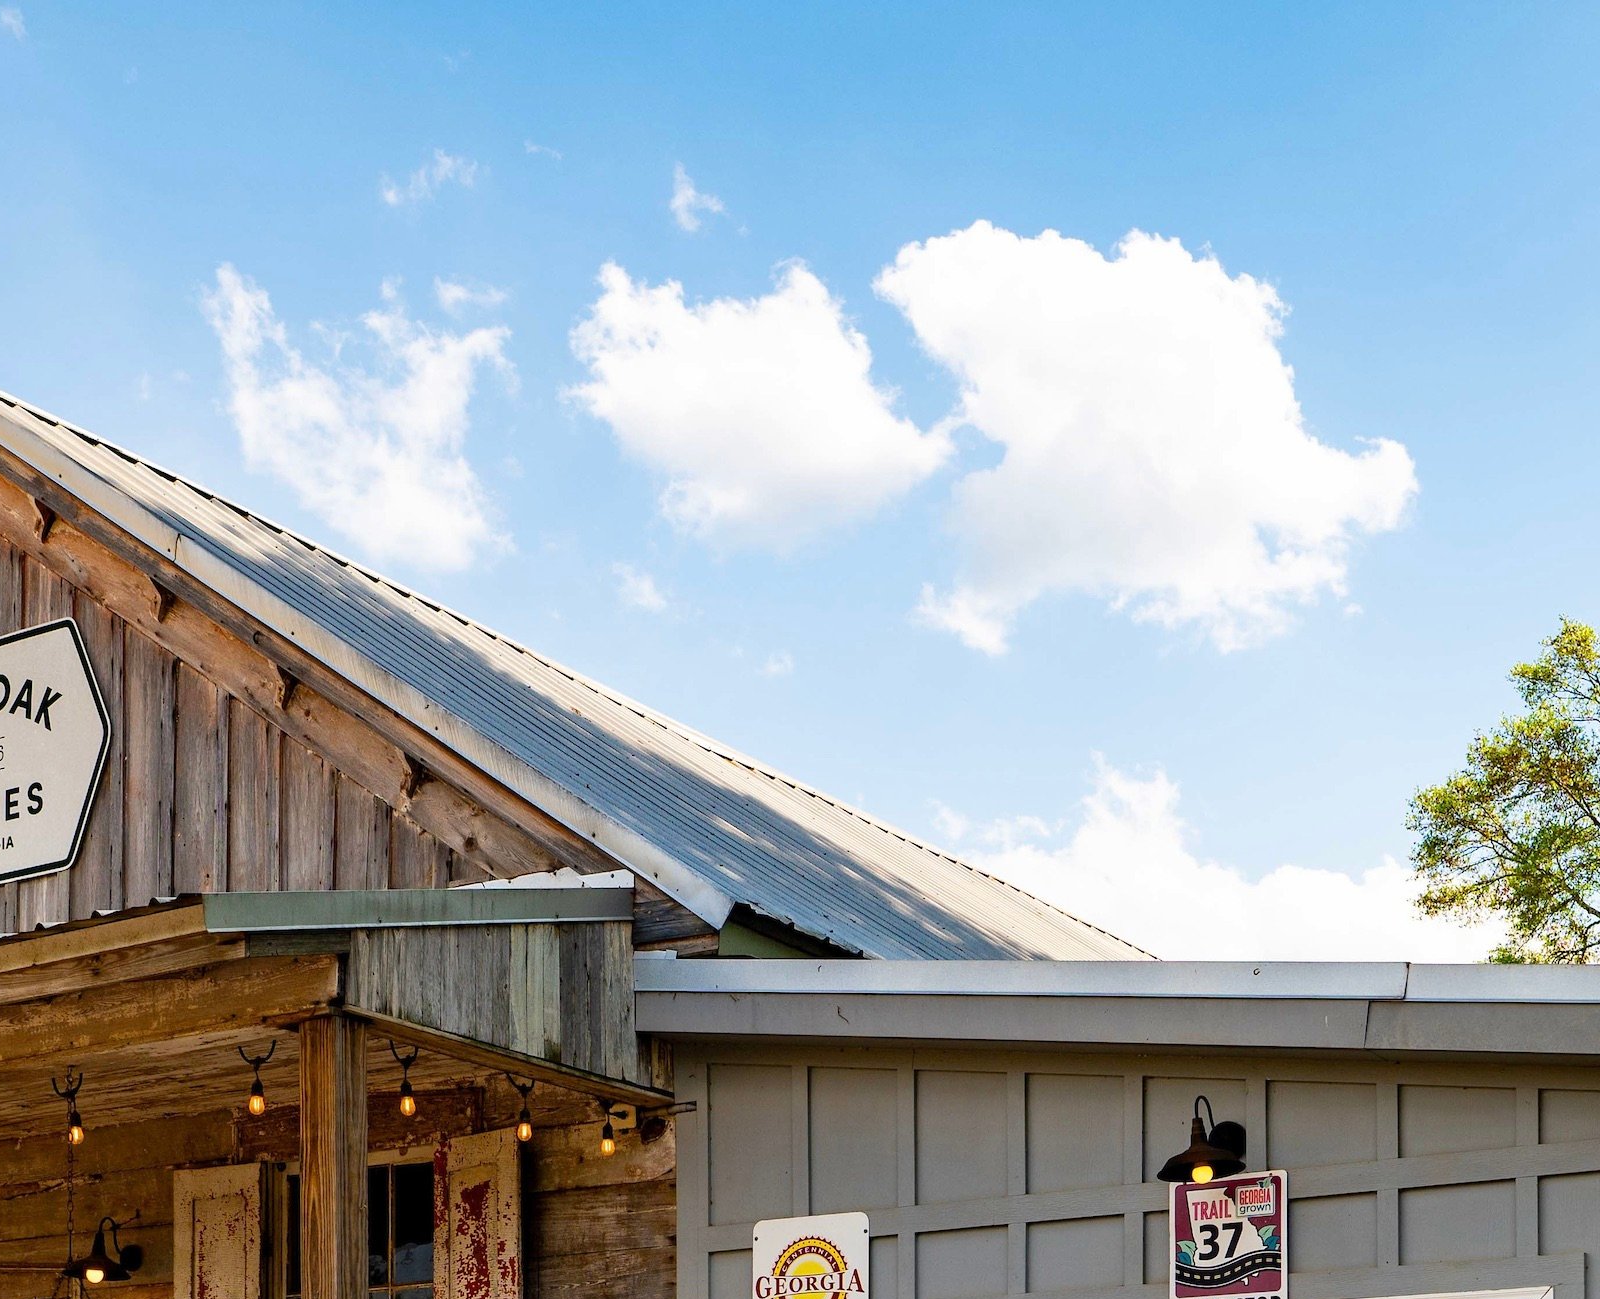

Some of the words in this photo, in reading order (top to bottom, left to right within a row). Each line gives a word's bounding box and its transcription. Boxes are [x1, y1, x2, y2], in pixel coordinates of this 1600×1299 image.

[1240, 1188, 1271, 1206] GEORGIA
[1192, 1200, 1232, 1221] TRAIL
[1240, 1204, 1271, 1215] grown
[1198, 1222, 1243, 1261] 37
[781, 1246, 837, 1272] CENTENNIAL
[755, 1268, 865, 1299] GEORGIA
